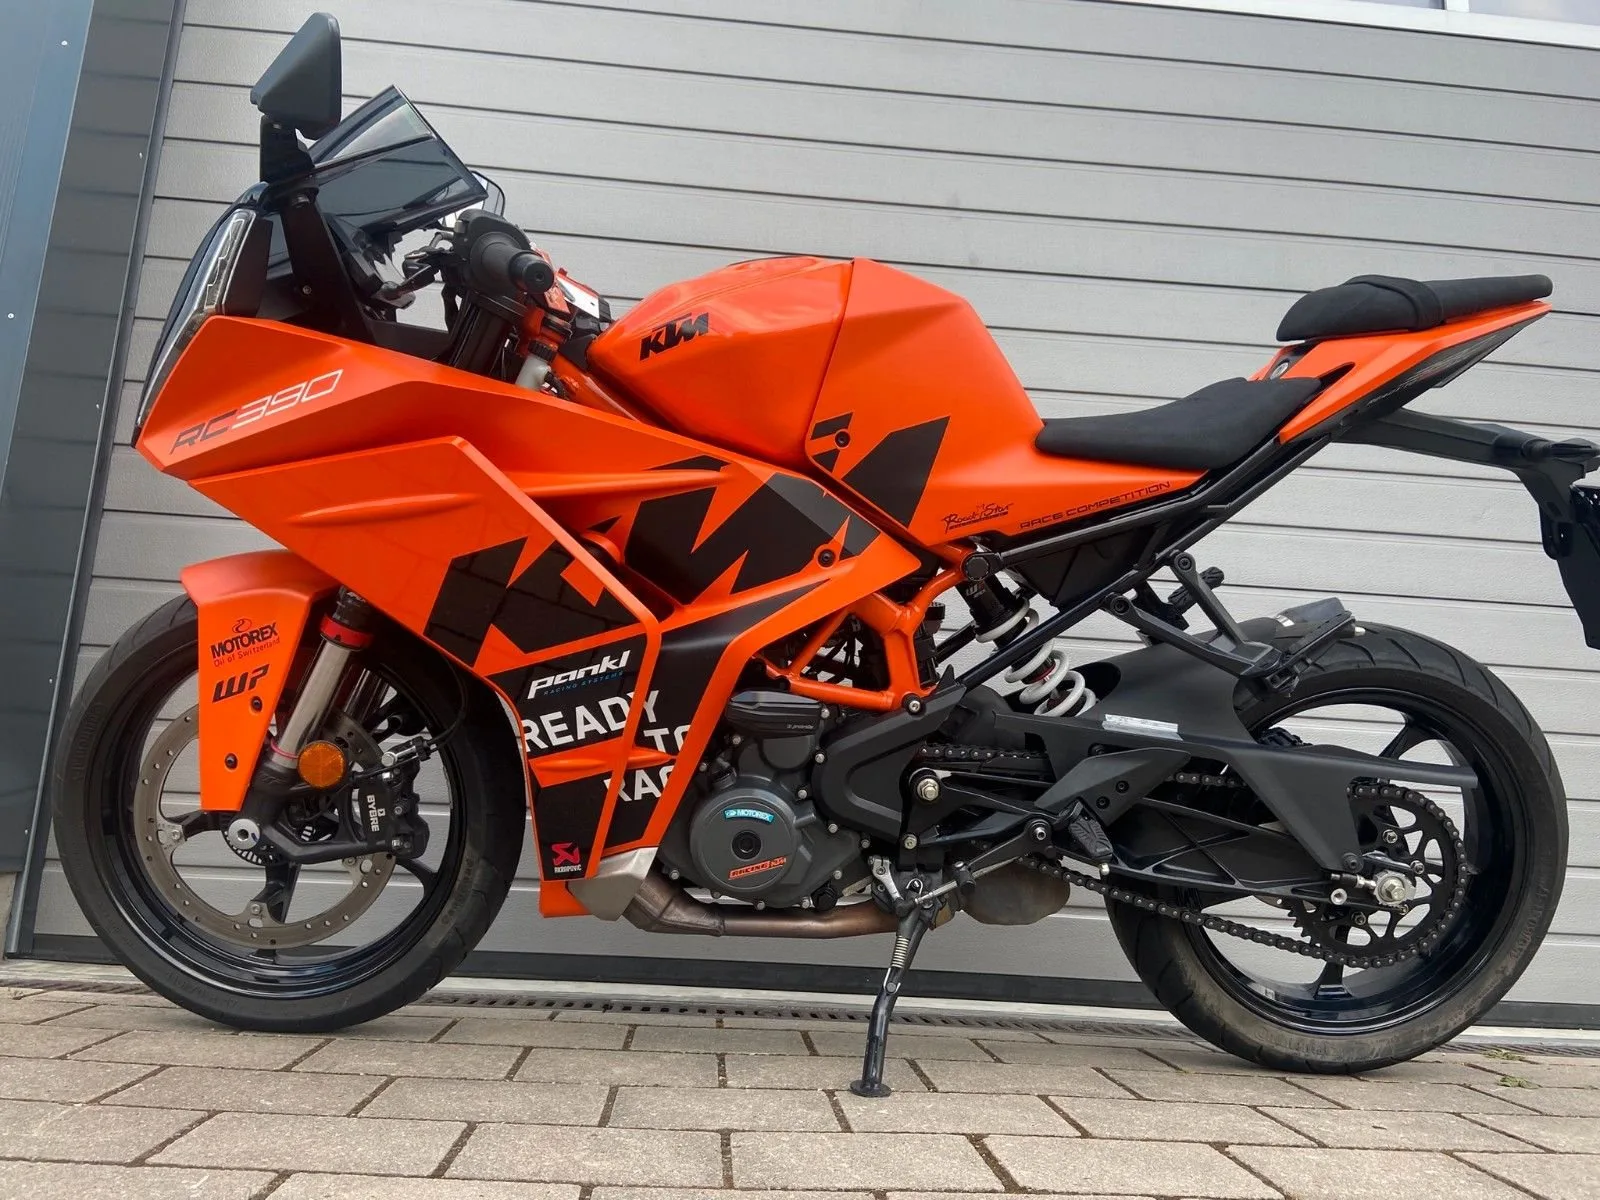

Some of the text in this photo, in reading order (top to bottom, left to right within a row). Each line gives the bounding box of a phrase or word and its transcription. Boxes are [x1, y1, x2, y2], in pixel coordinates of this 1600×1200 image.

[640, 312, 709, 361] KTM
[1020, 481, 1170, 529] RACE COMPETITION
[211, 622, 278, 658] MOTOREX
[227, 654, 235, 662] of
[237, 636, 280, 659] Switzerland
[212, 663, 270, 703] WP
[520, 689, 660, 753] READY
[366, 794, 380, 832] BYBRE
